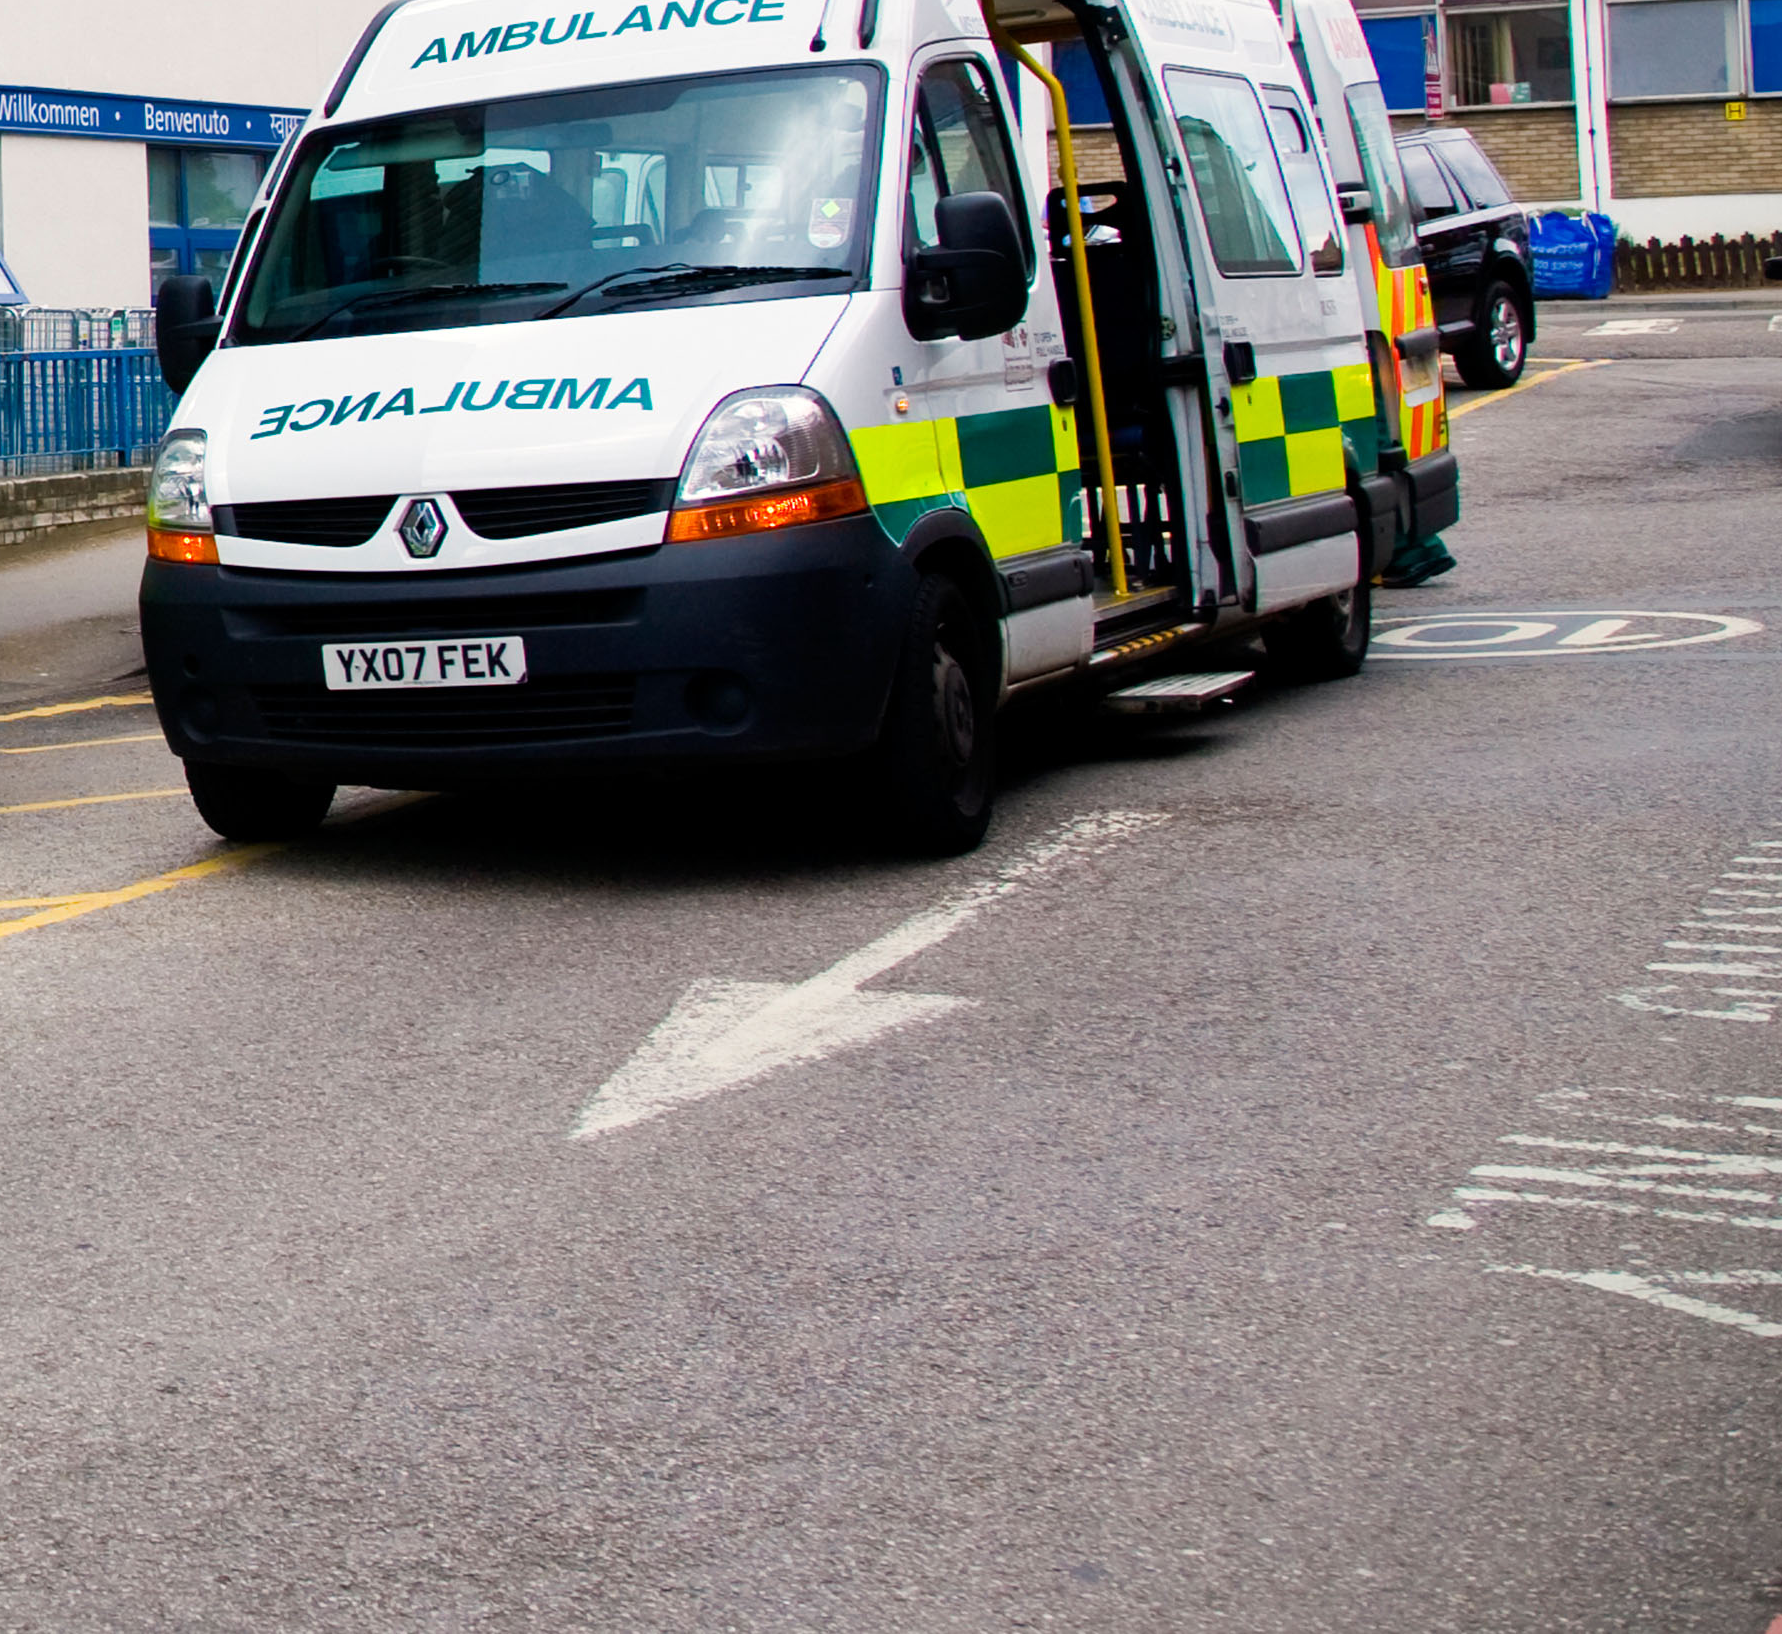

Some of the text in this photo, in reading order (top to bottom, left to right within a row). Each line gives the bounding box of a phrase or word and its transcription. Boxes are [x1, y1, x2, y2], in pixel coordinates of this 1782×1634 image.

[145, 103, 230, 135] Benvenuto
[336, 643, 511, 682] YX07 FEK
